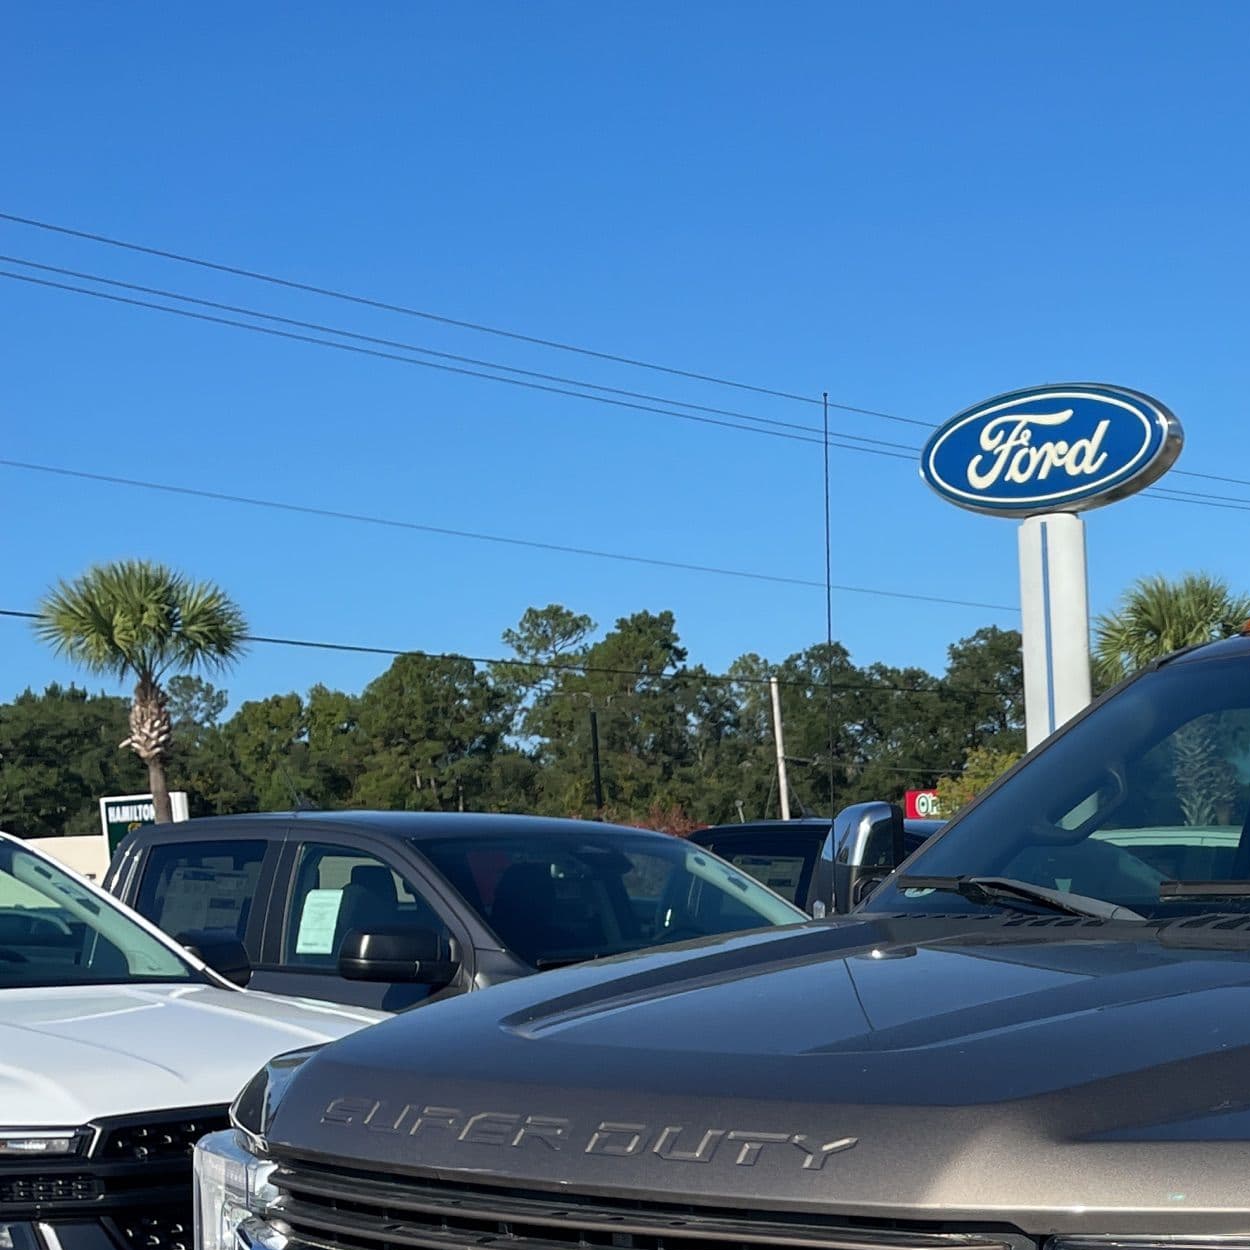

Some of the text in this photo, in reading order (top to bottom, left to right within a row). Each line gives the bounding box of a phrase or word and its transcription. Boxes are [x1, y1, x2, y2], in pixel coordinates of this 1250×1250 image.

[966, 408, 1110, 490] Ford
[320, 1098, 859, 1171] SUPER DUTY
